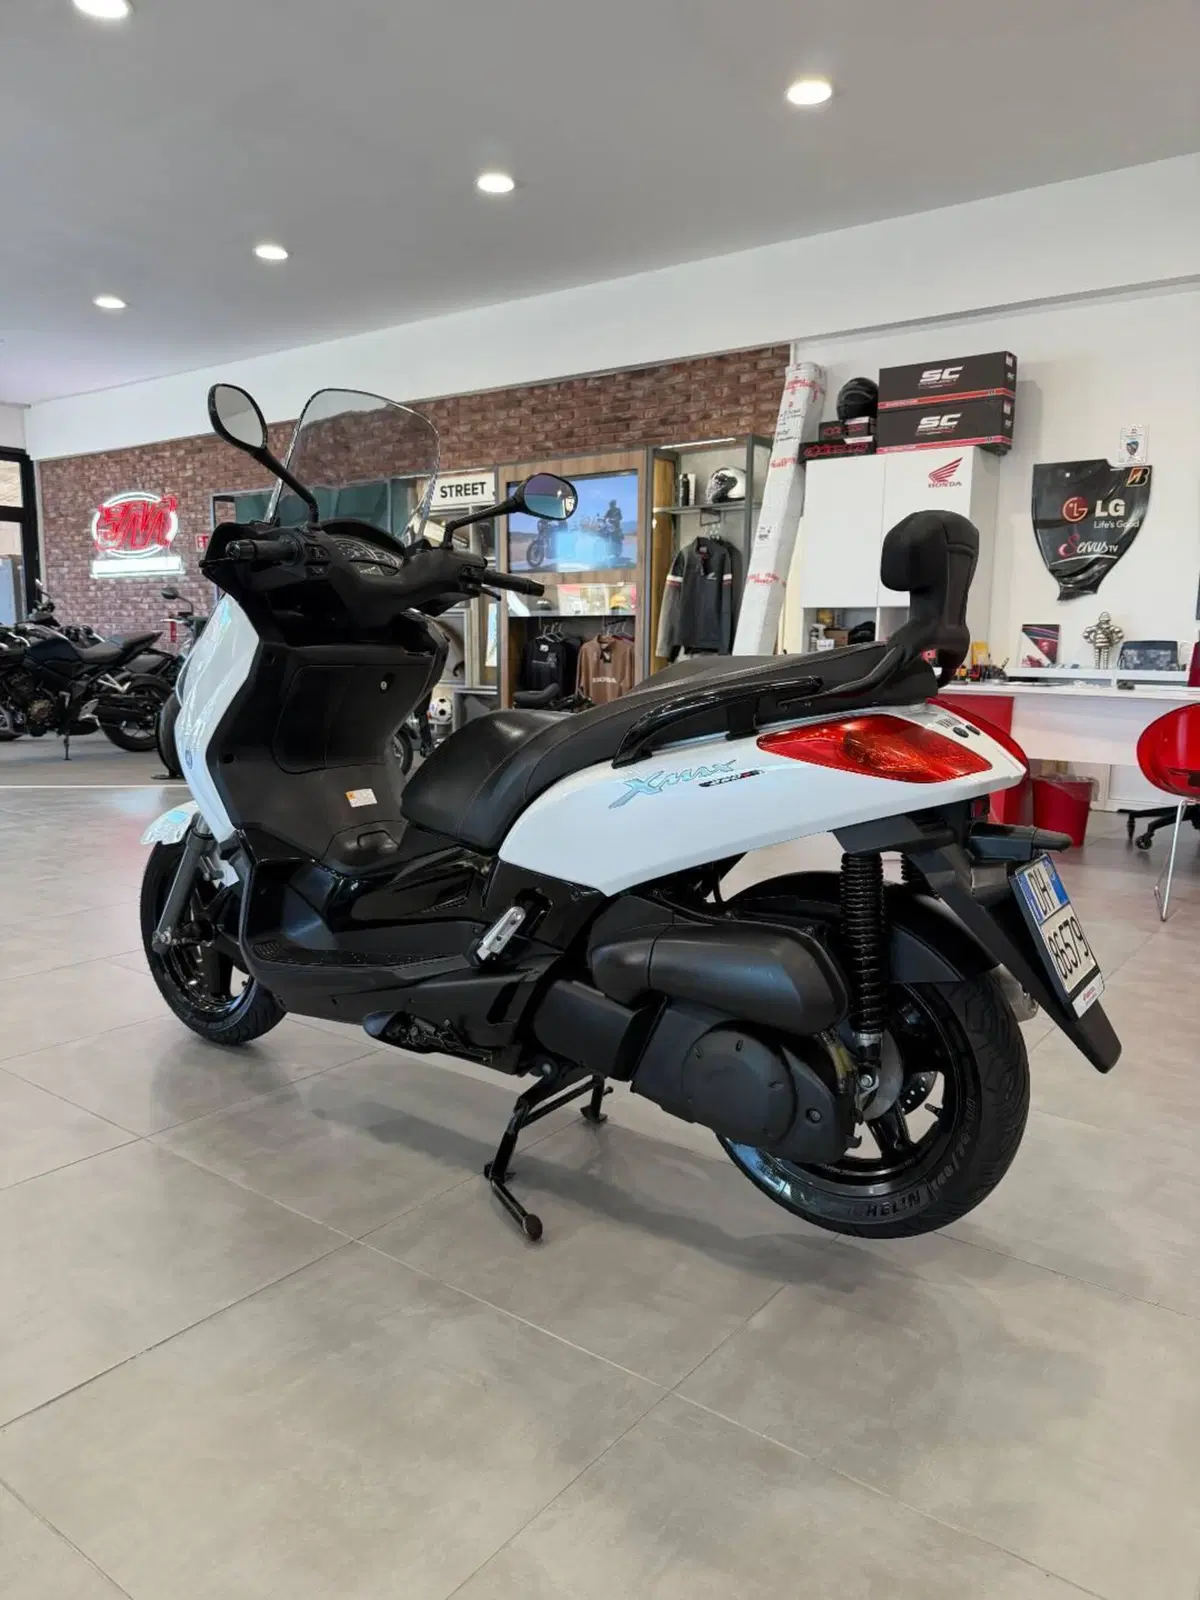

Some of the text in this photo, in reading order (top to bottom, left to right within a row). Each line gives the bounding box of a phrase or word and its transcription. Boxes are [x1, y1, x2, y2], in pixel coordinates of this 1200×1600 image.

[919, 365, 964, 383] SC
[917, 412, 962, 430] SC
[440, 482, 486, 498] STREET
[1094, 498, 1126, 517] LG
[1093, 519, 1140, 529] Life's Good
[1028, 867, 1056, 916] DH
[1047, 916, 1089, 980] 86579
